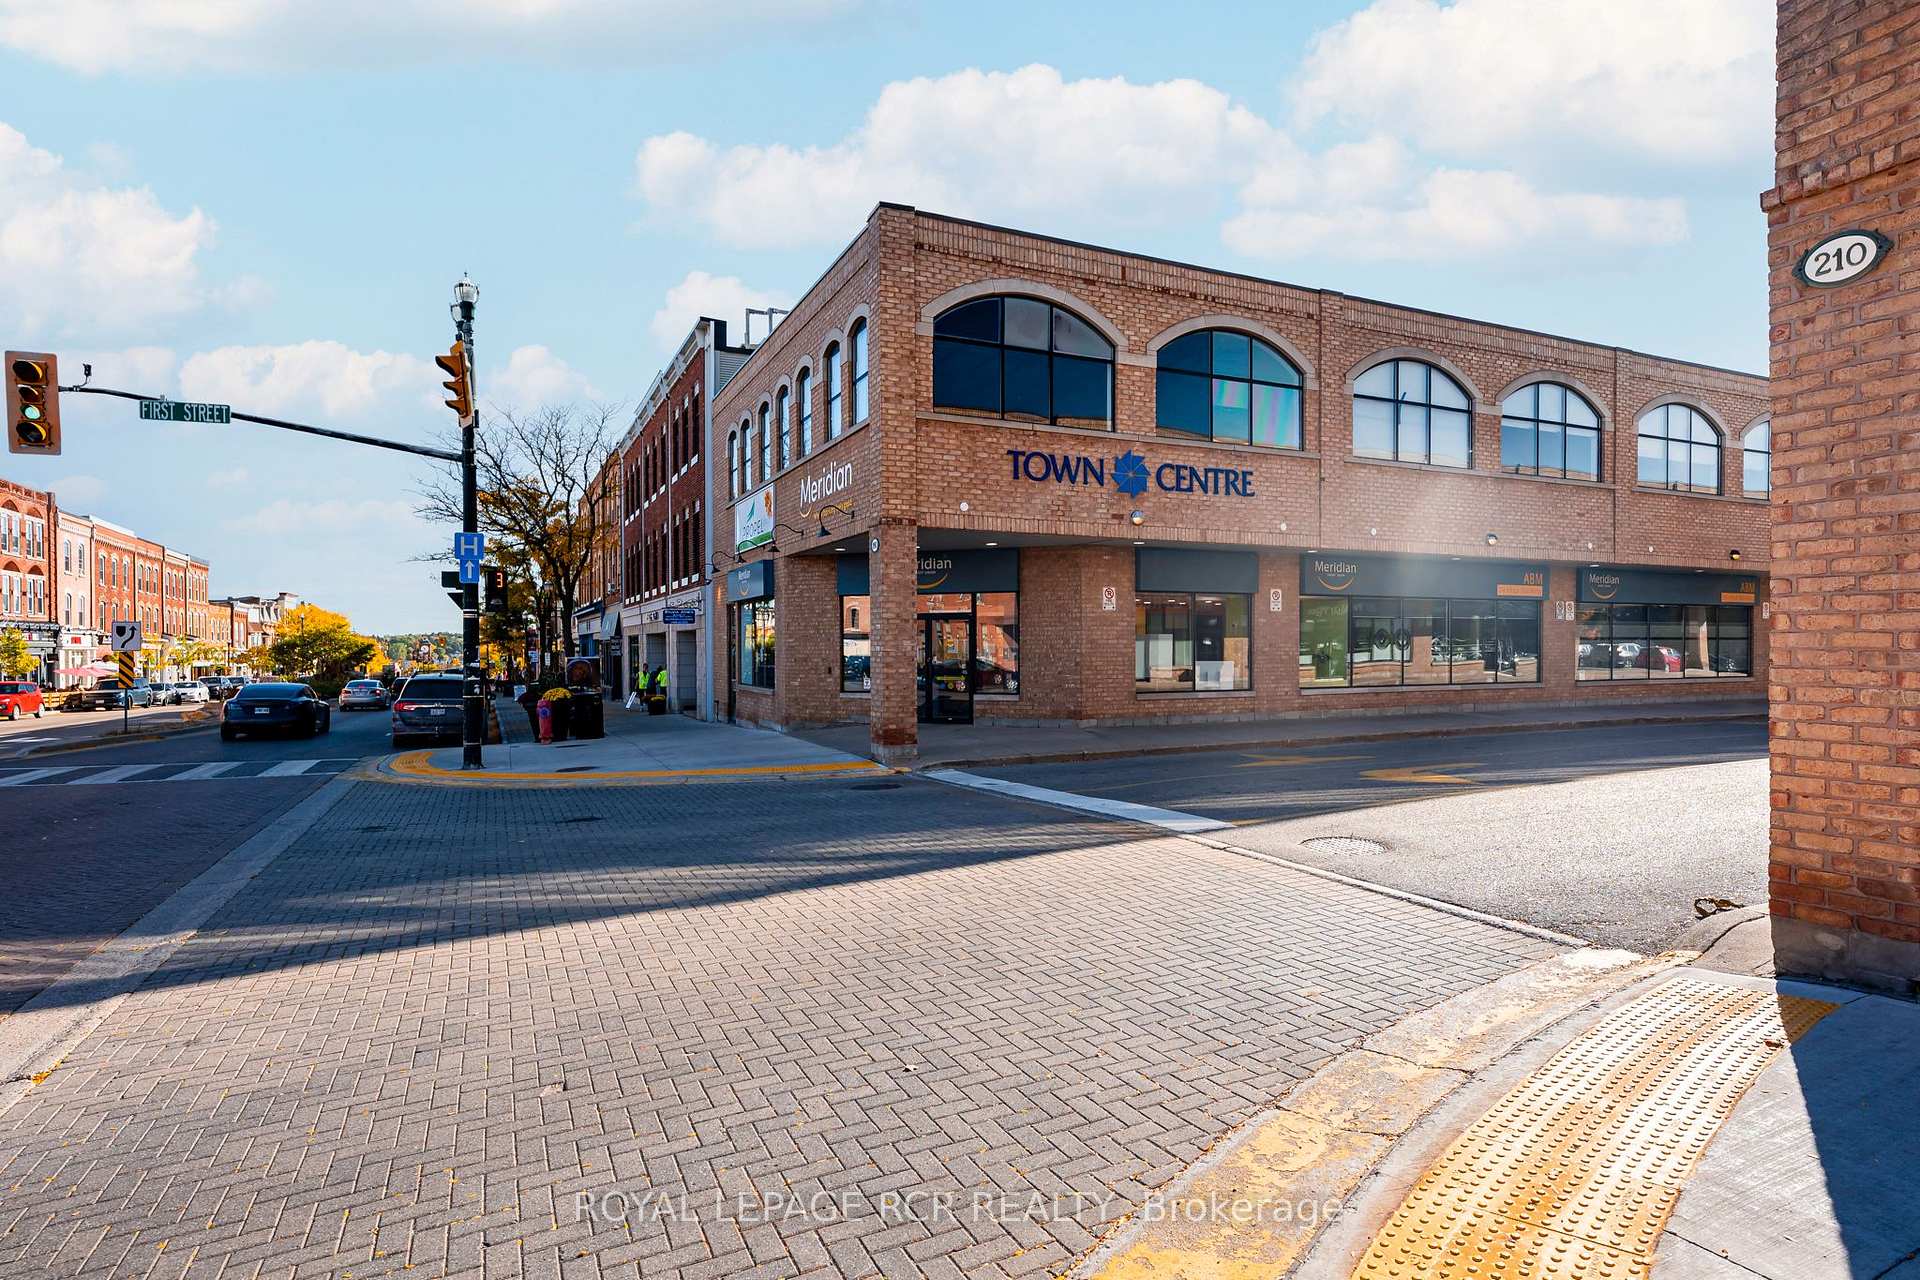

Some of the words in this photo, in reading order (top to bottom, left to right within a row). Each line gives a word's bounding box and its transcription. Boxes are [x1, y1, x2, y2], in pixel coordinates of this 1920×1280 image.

[1814, 242, 1867, 277] 210
[142, 401, 175, 420] FIRST
[183, 403, 228, 423] STREET
[1007, 449, 1105, 486] TOWN
[1156, 463, 1255, 497] CENTRE
[800, 461, 852, 508] Meridian
[460, 536, 478, 556] H
[916, 558, 952, 571] ridian
[1314, 560, 1357, 573] Meridian
[1523, 572, 1543, 585] ABM
[1589, 573, 1620, 585] Meridian
